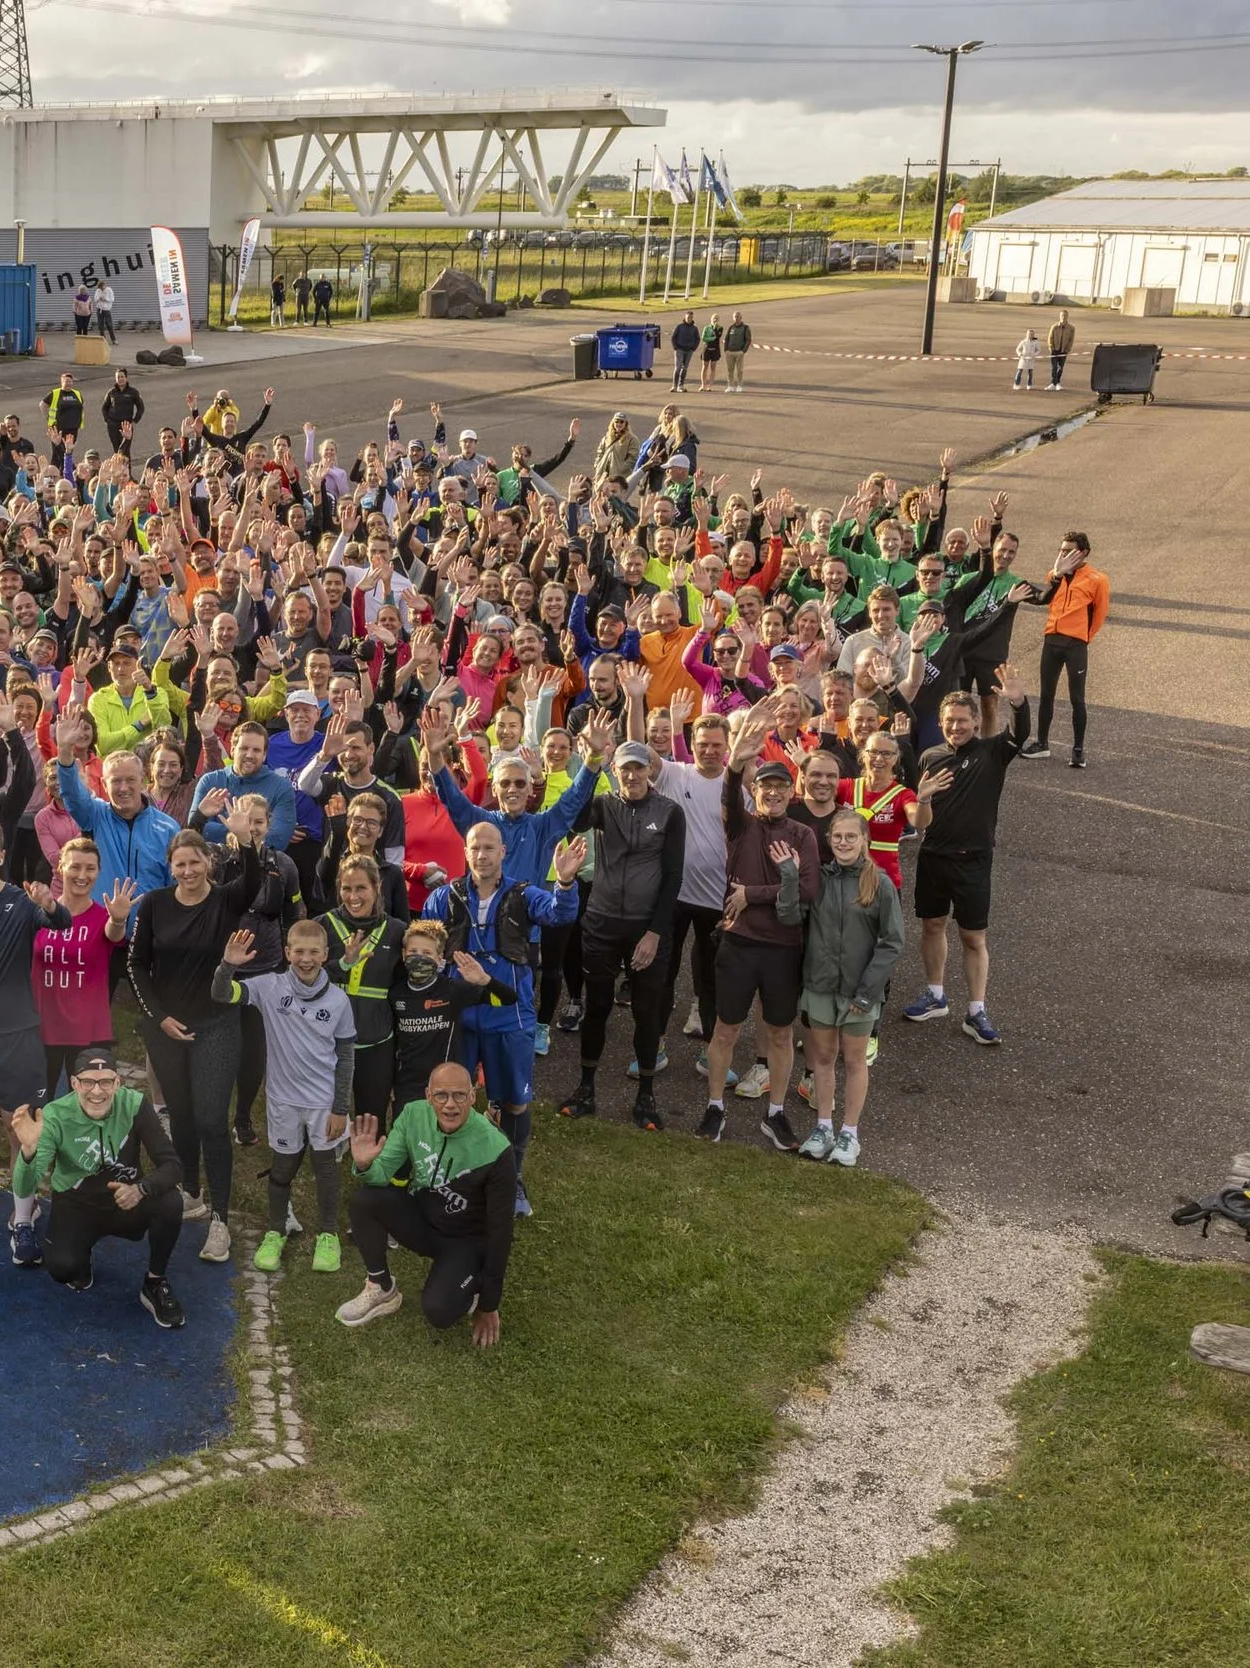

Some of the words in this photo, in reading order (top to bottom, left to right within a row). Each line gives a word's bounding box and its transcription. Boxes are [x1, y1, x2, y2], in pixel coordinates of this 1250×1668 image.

[44, 944, 85, 965] ALL
[44, 969, 85, 988] OUT
[400, 1015, 443, 1026] NATIONALE
